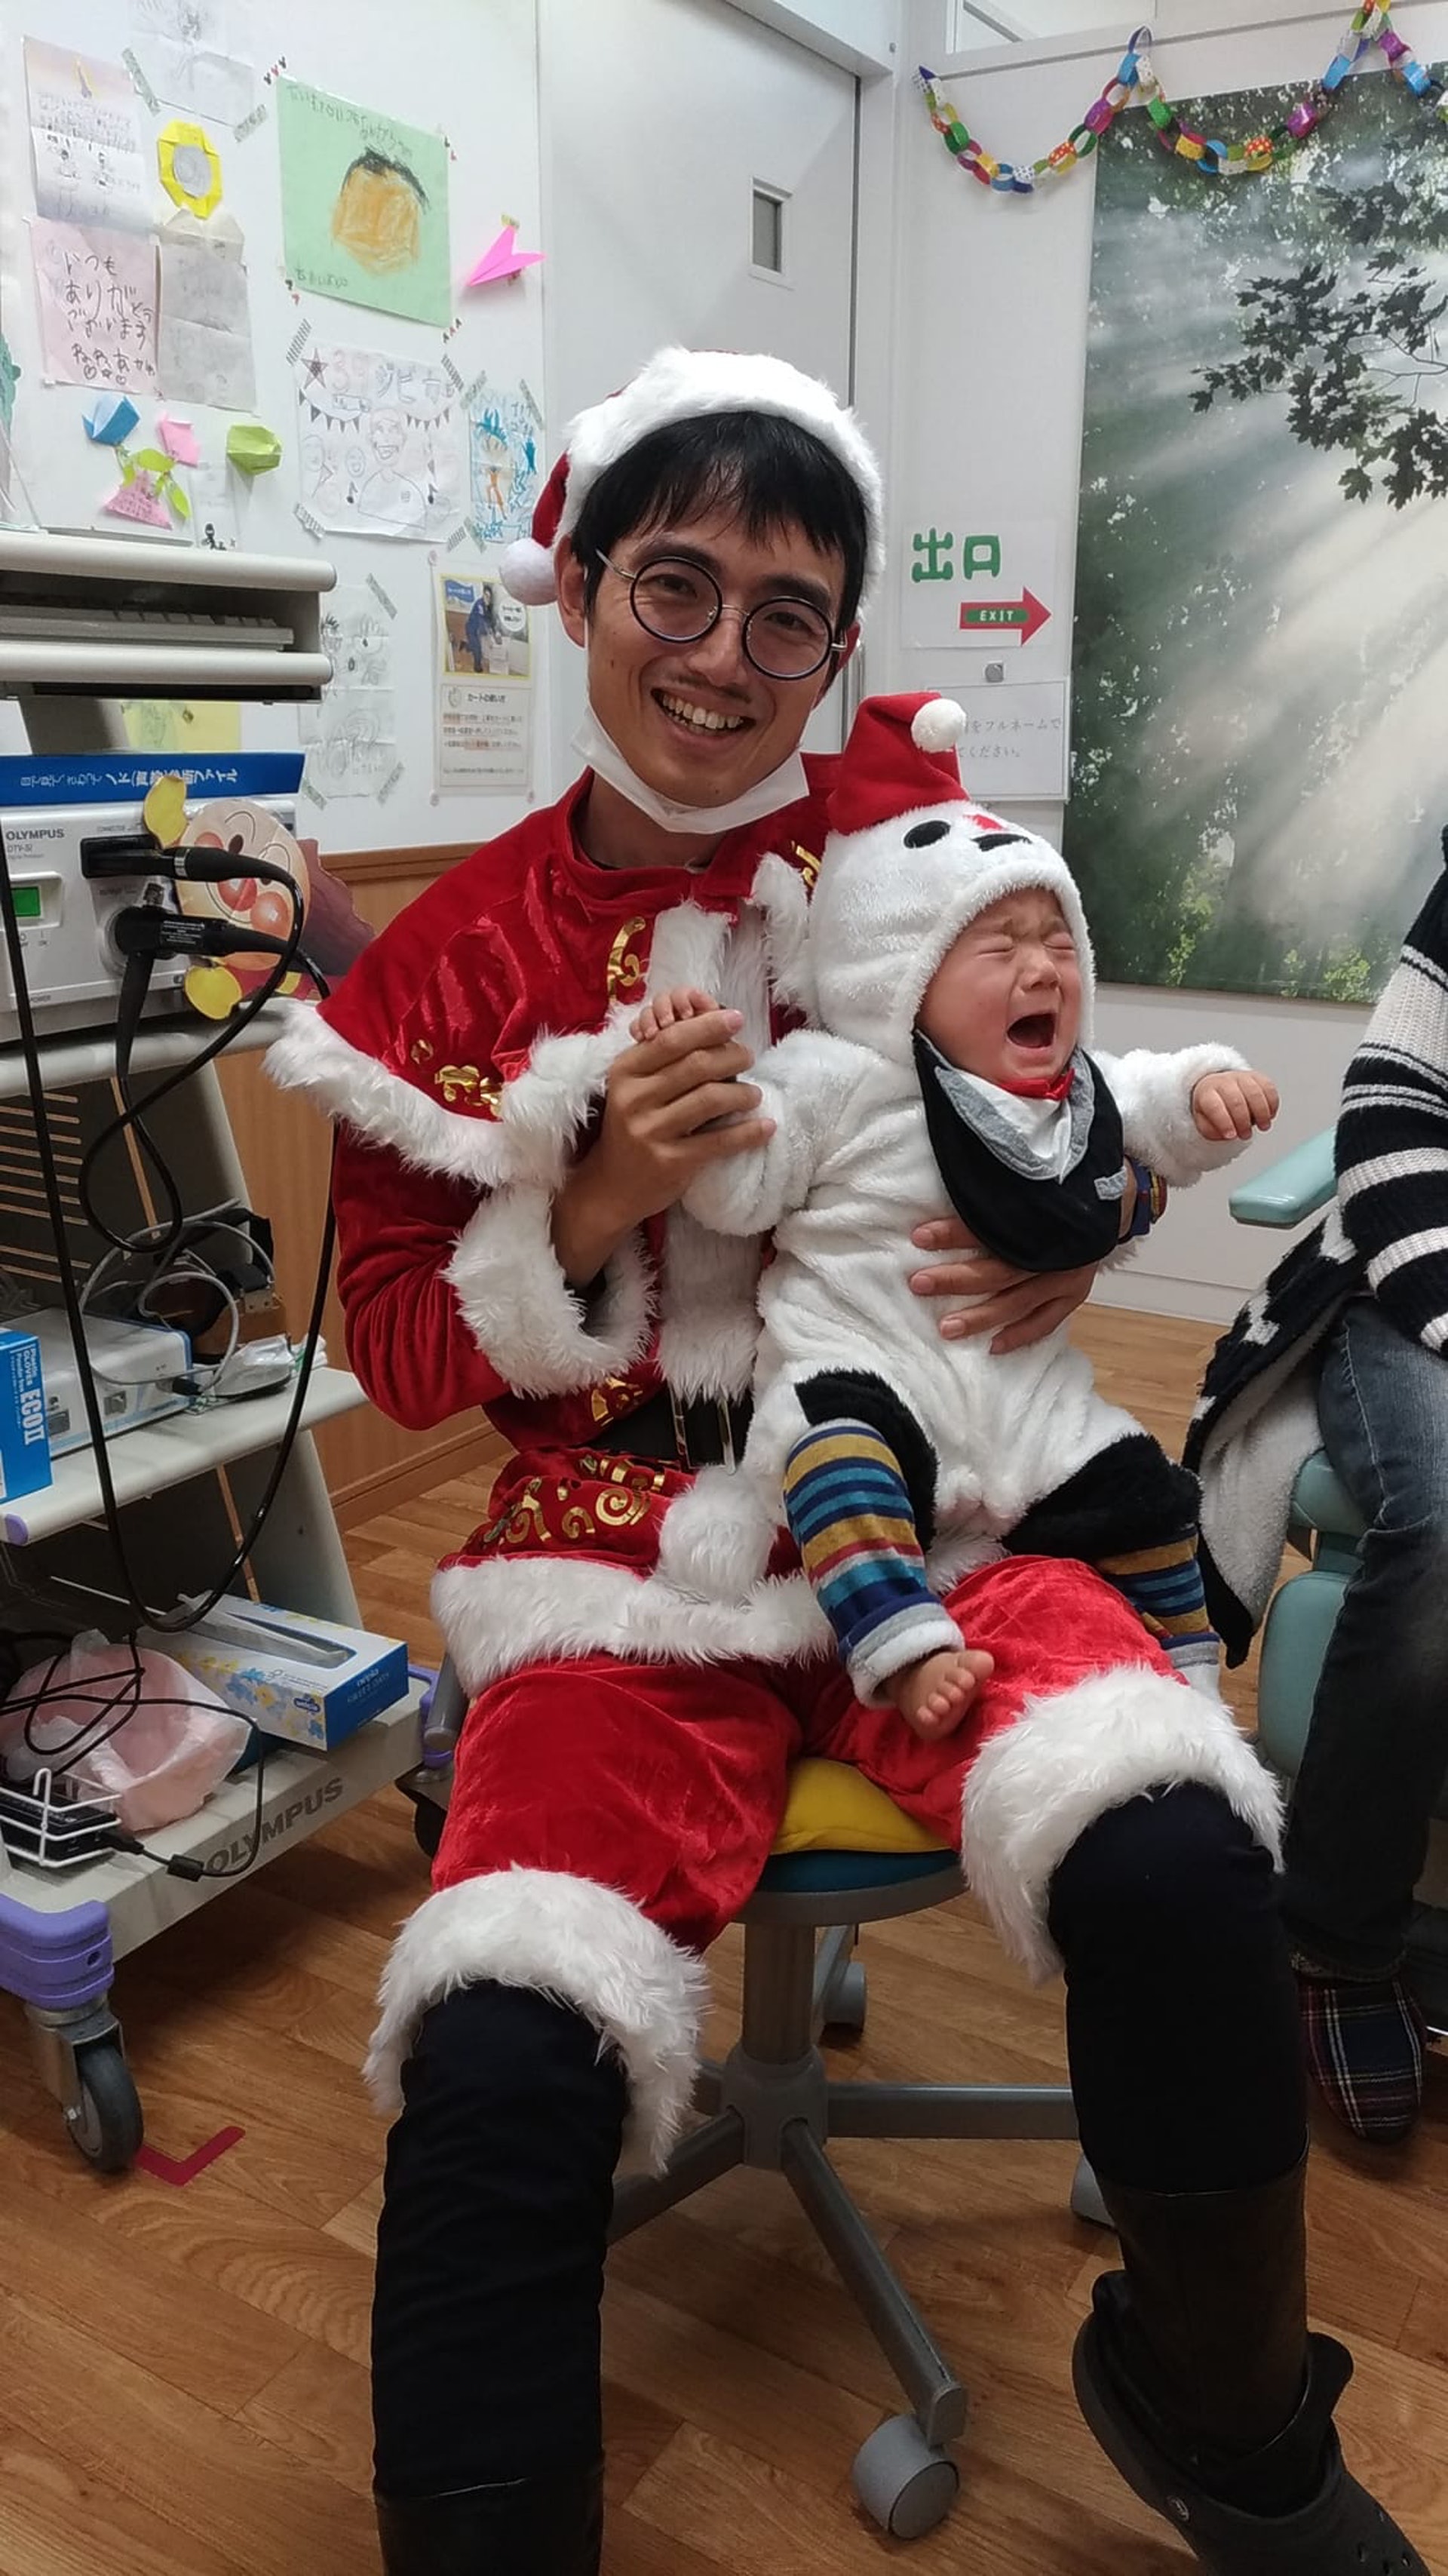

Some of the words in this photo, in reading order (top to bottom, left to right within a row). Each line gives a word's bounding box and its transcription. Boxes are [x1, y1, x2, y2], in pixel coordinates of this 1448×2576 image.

[65, 252, 117, 276] いつも
[911, 527, 1002, 583] 出口
[980, 609, 1014, 622] EXIT
[964, 717, 1062, 734] をフルネームで
[6, 828, 65, 841] OLYMPUS
[23, 1349, 33, 1386] GLOVES
[206, 1776, 344, 1873] OLYMPUS
